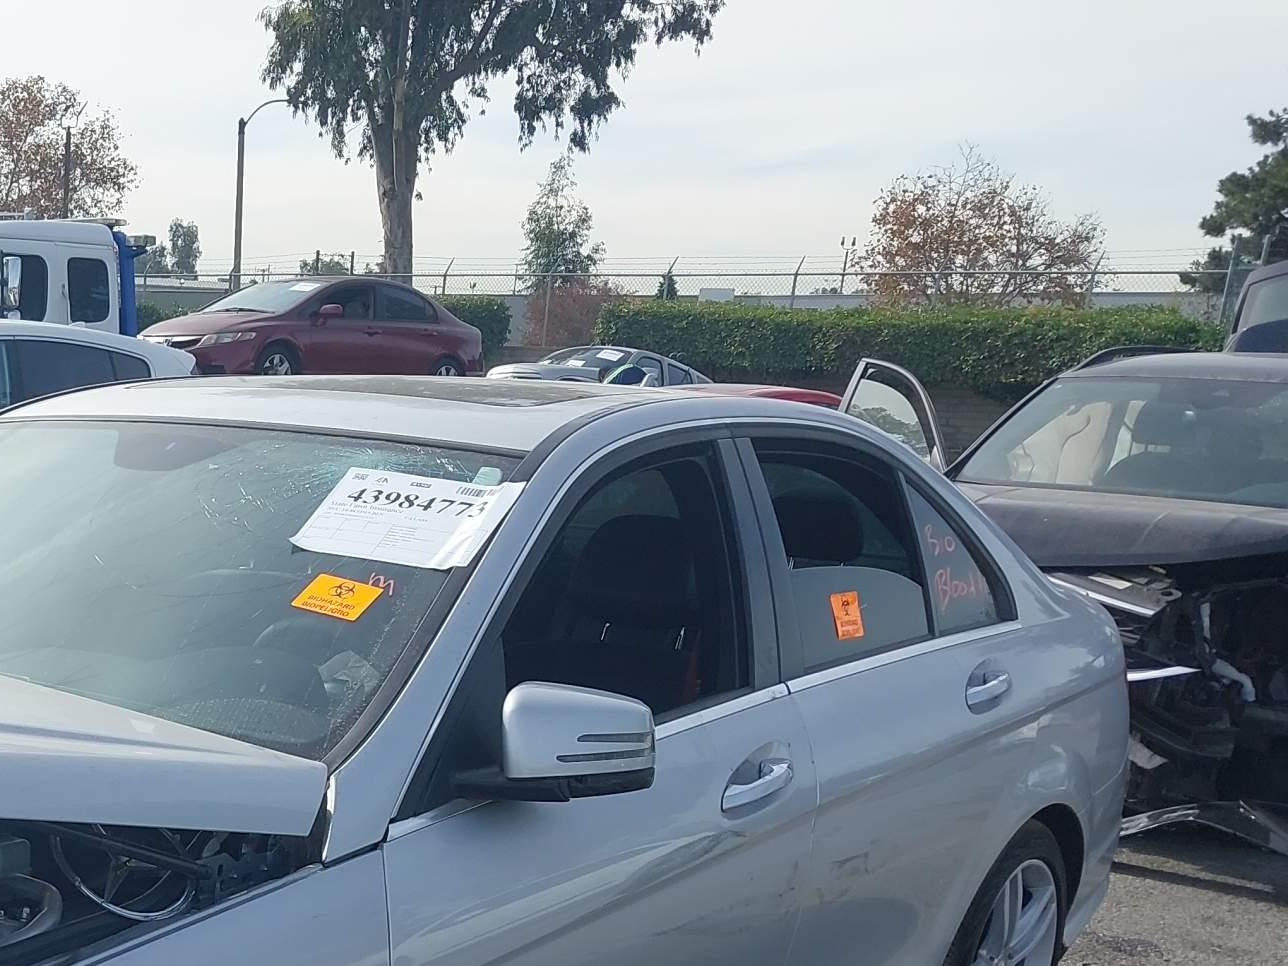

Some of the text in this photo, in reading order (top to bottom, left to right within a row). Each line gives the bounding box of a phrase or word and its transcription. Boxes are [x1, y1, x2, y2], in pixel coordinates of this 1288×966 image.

[346, 487, 489, 518] 43984773
[301, 601, 350, 617] BIOPELIGRO
[307, 594, 356, 611] BIOHAZARD
